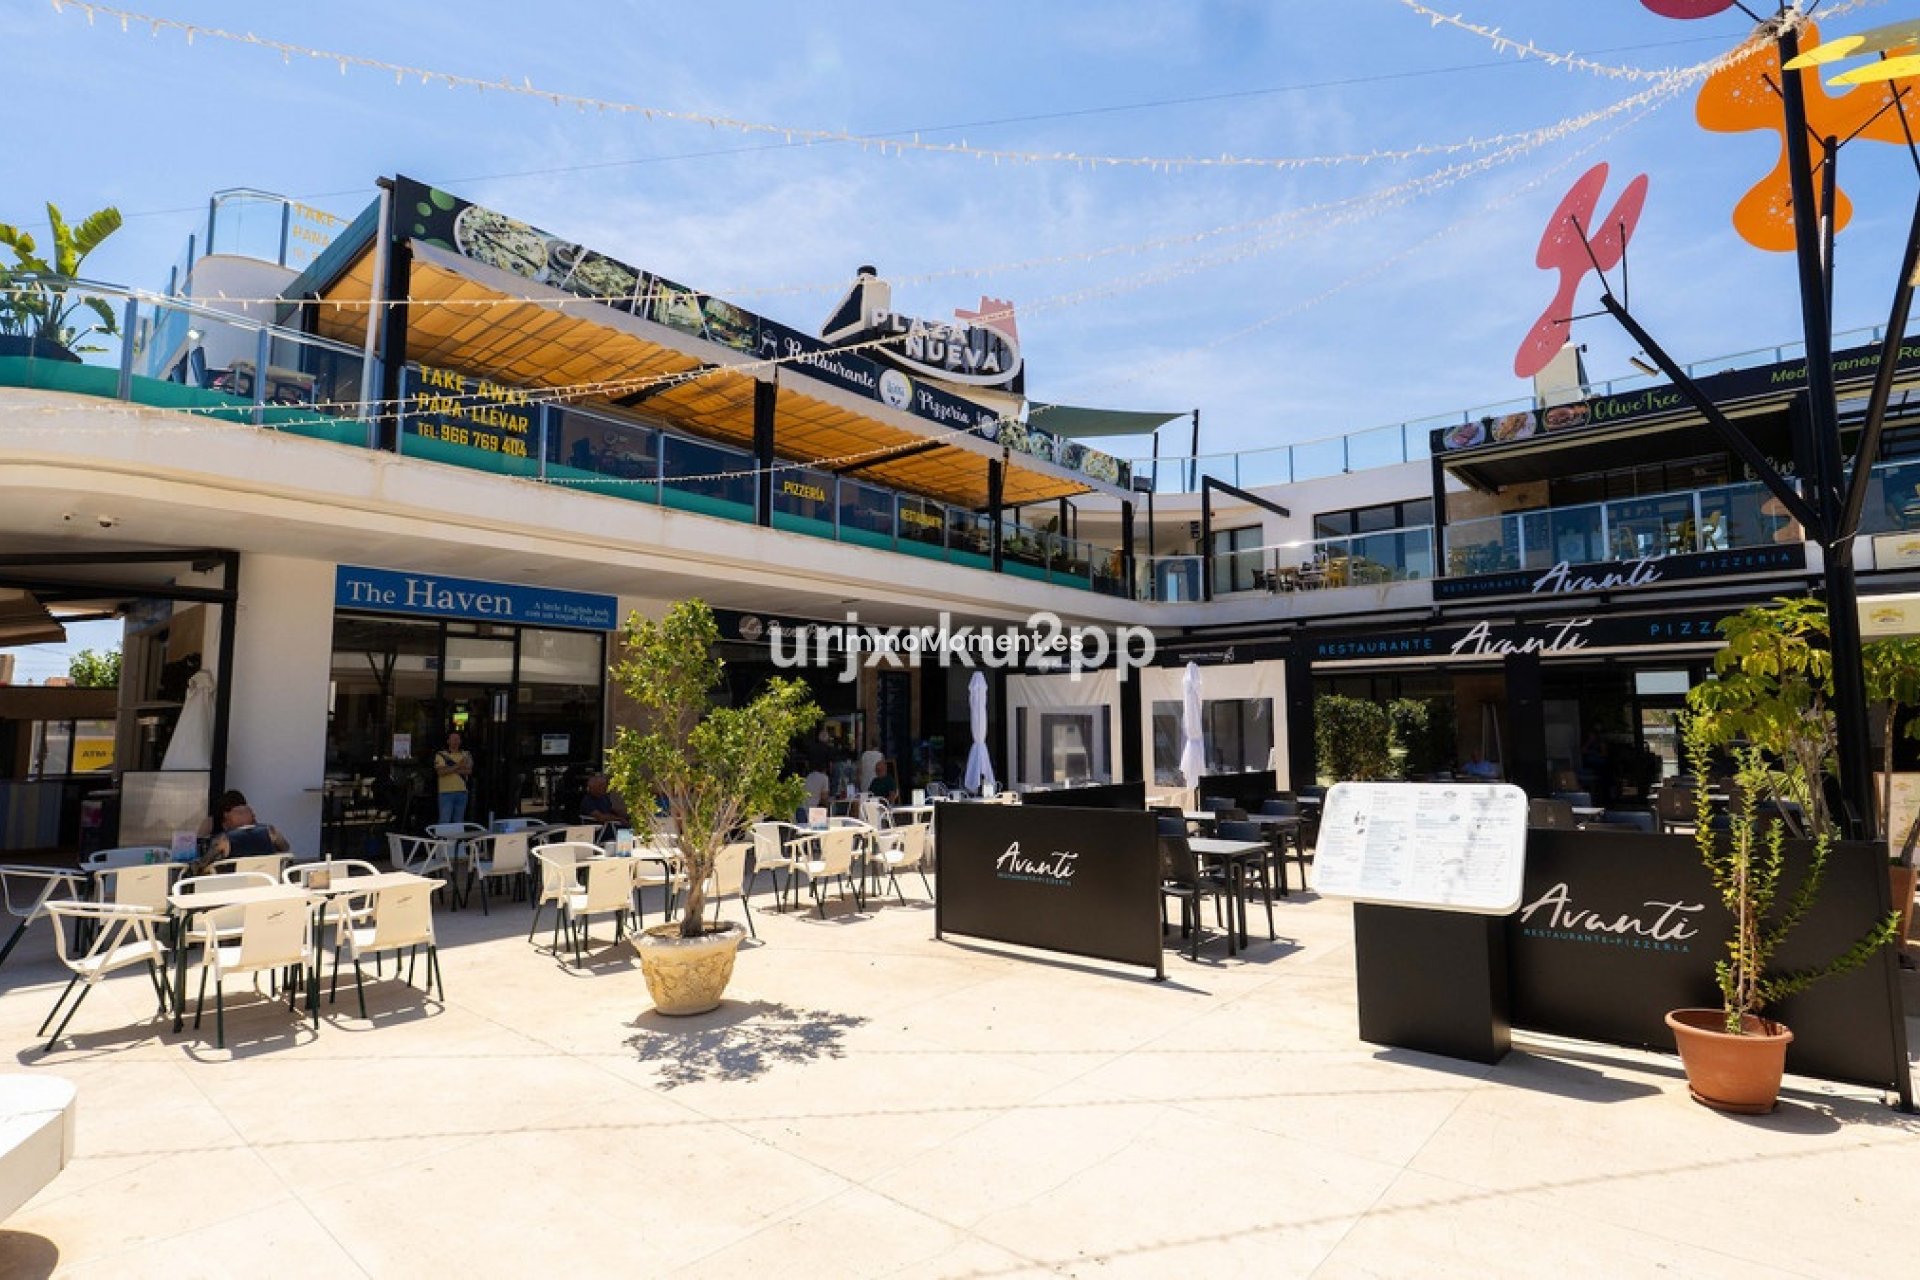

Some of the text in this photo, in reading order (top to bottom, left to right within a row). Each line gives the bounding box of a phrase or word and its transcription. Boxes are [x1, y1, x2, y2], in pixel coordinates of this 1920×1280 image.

[871, 308, 969, 345] PLAZA
[784, 337, 877, 390] Restaurante
[905, 335, 1001, 372] NUEVA
[420, 365, 528, 408] TAKE AWAY
[418, 392, 528, 434] PARA LLEVAR
[441, 424, 469, 445] 966
[472, 431, 499, 452] 769
[502, 437, 528, 458] 404
[1532, 553, 1665, 593] Avanti
[1700, 551, 1790, 570] PIZZERIA
[346, 577, 512, 615] The Haven
[1318, 638, 1433, 656] RESTAURANTE
[1450, 618, 1594, 655] Avanti
[996, 841, 1079, 879] Avanti
[1520, 882, 1705, 941] Avanti
